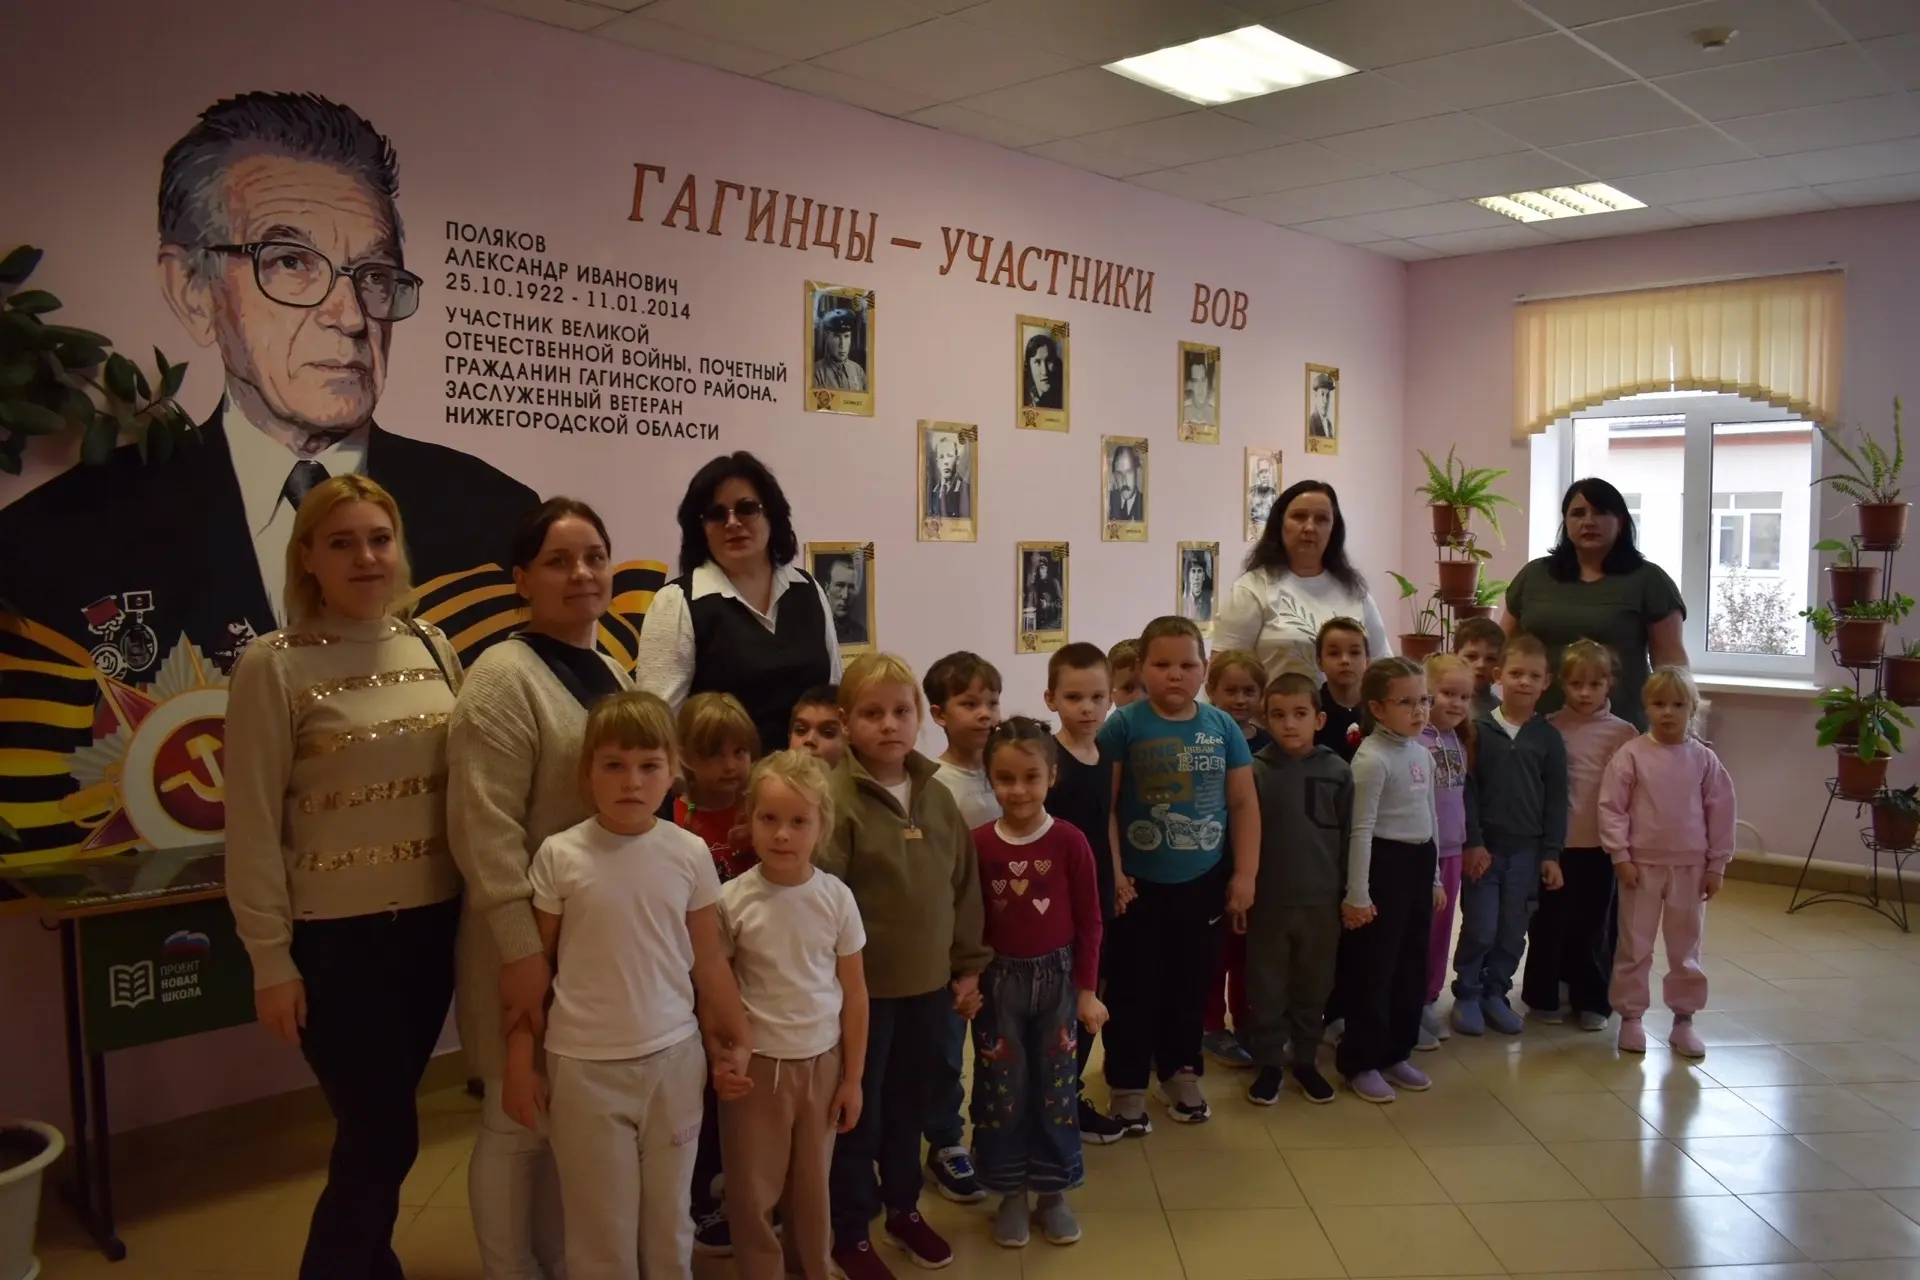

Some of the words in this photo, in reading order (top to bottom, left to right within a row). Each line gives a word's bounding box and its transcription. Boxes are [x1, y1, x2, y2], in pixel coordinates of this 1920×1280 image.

[446, 221, 546, 252] ПОЛЯКОВ
[627, 162, 878, 263] ГАГИНЦЫ
[938, 227, 1155, 314] УЧАСТНИКИ
[1191, 282, 1249, 331] ВОВ
[445, 247, 568, 281] АЛЕКСАНДР
[577, 265, 678, 295] ИВАНОВИЧ
[446, 272, 564, 303] 25.10.1922
[587, 291, 690, 320] 11.01.2014
[446, 306, 553, 334] УЧАСТНИК
[562, 319, 649, 345] ВЕЛИКОЙ
[445, 331, 613, 364] ОТЕЧЕСТВЕННОЙ
[622, 348, 692, 374] ВОЙНЫ,
[700, 357, 787, 383] ПОЧЕТНЫЙ
[446, 356, 571, 384] ГРАЖДАНИН
[579, 368, 697, 394] ГАГИНСКОГО
[445, 380, 601, 410] ЗАСЛУЖЕННЫЙ
[610, 395, 682, 415] ВЕТЕРАН
[446, 406, 628, 434] НИЖЕГОРОДСКОЙ
[636, 419, 719, 440] ОБЛАСТИ
[160, 960, 200, 977] ПРОЕКТ
[161, 974, 199, 989] НОВАЯ
[161, 987, 202, 1003] ШКОЛА
